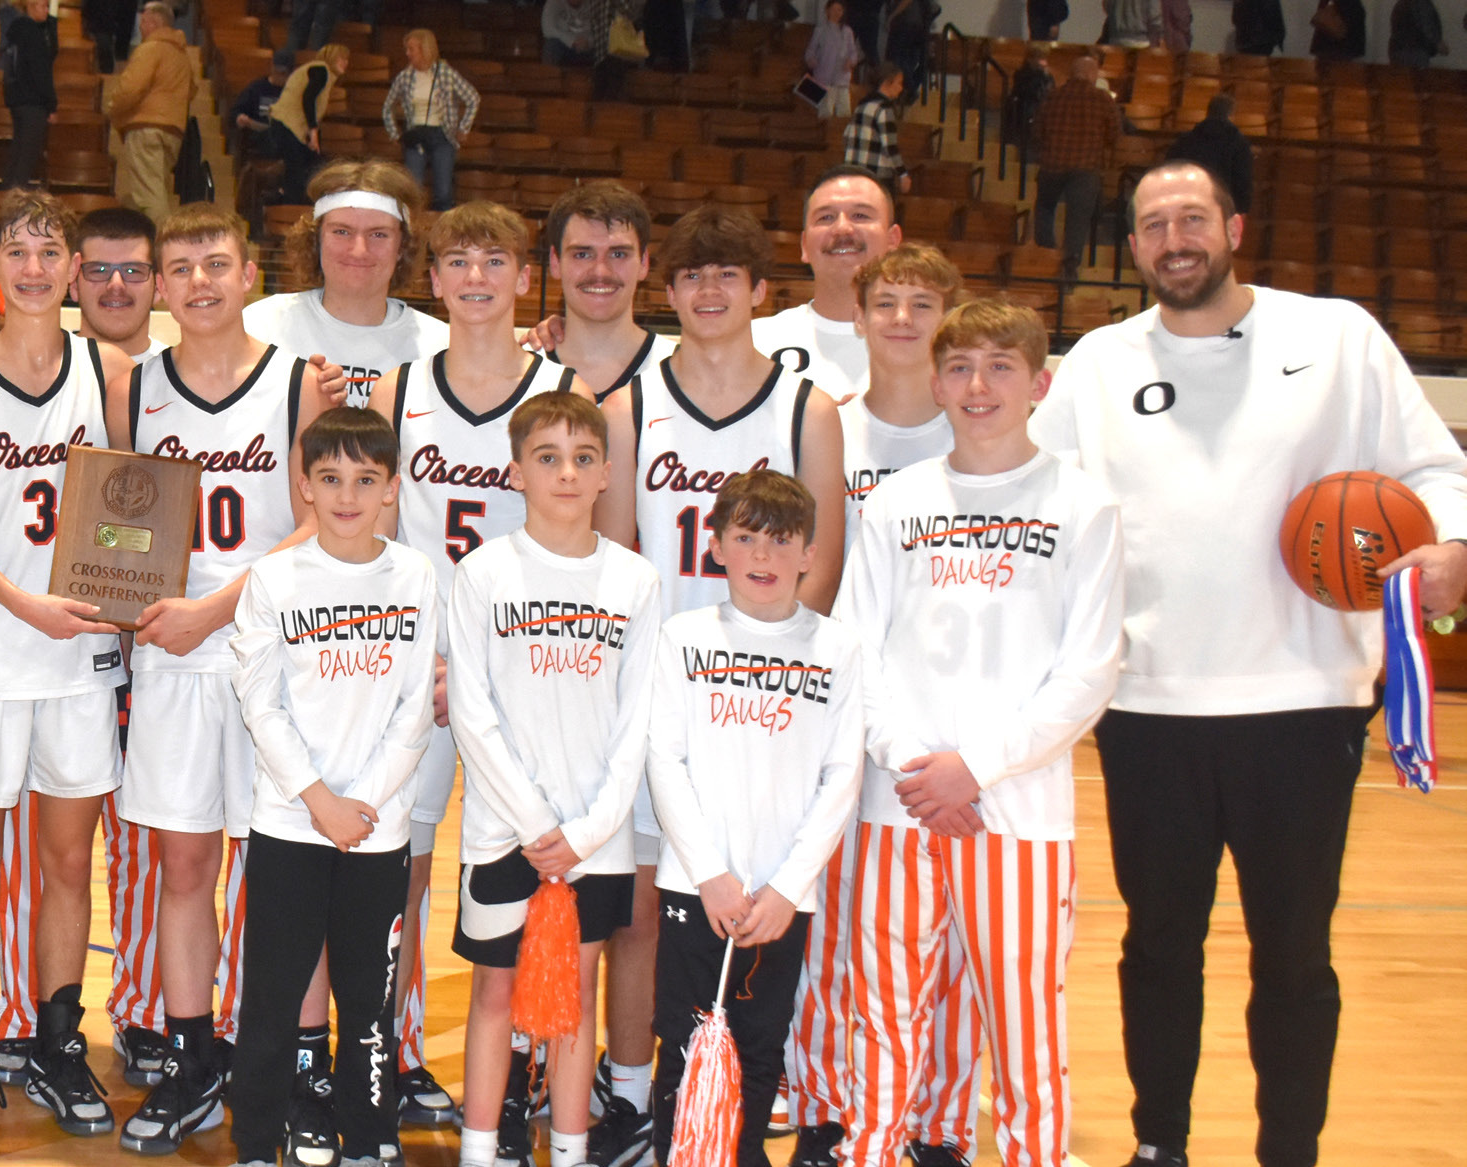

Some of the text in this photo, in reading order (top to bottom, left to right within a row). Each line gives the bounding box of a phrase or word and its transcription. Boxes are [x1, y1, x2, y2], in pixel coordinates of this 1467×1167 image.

[410, 444, 514, 492] Osceo
[645, 450, 770, 494] Osce
[23, 478, 58, 547] 3
[445, 498, 487, 566] 5
[900, 514, 1060, 559] UNDERDOGS
[68, 581, 161, 605] CONFERENCE
[71, 562, 165, 588] CROSSROADS
[930, 552, 1015, 593] DAWGS
[280, 604, 421, 645] UNDERDOG
[493, 600, 631, 650] UNDERDOG
[318, 642, 393, 682] DAWGS
[529, 642, 603, 683] DAWGS
[682, 646, 833, 705] UNDERDOGS
[710, 692, 793, 737] DAWGS
